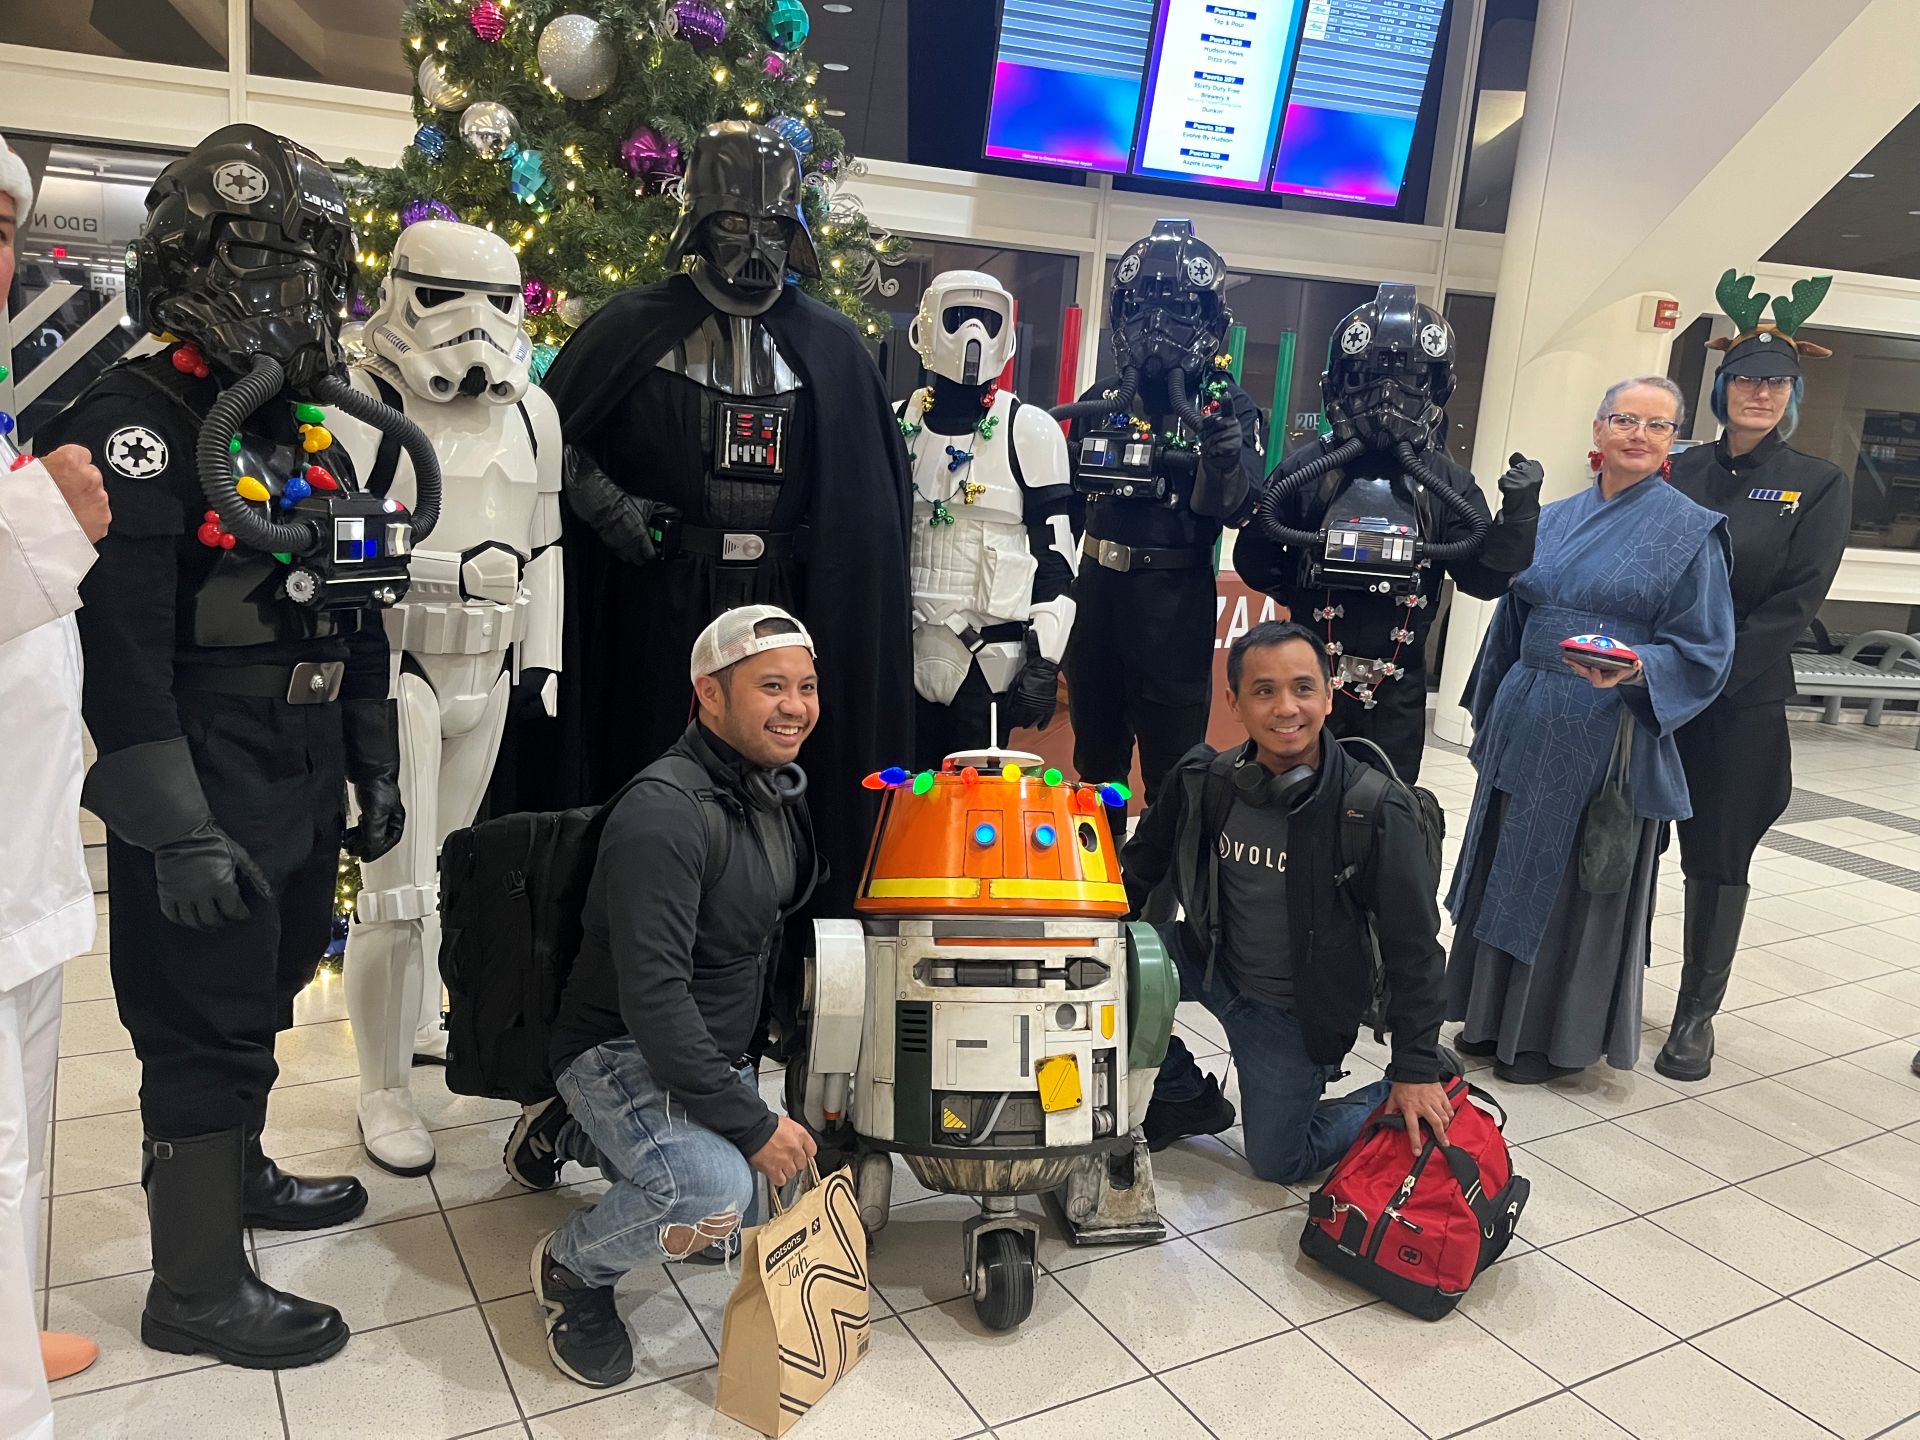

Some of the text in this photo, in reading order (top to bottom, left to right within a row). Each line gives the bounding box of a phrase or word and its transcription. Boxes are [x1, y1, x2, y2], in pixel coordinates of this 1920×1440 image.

[1204, 46, 1226, 54] Hudson
[1212, 85, 1226, 93] Duty
[1182, 132, 1201, 140] Evolve
[1202, 162, 1223, 170] Lounge
[768, 1234, 802, 1265] watsons
